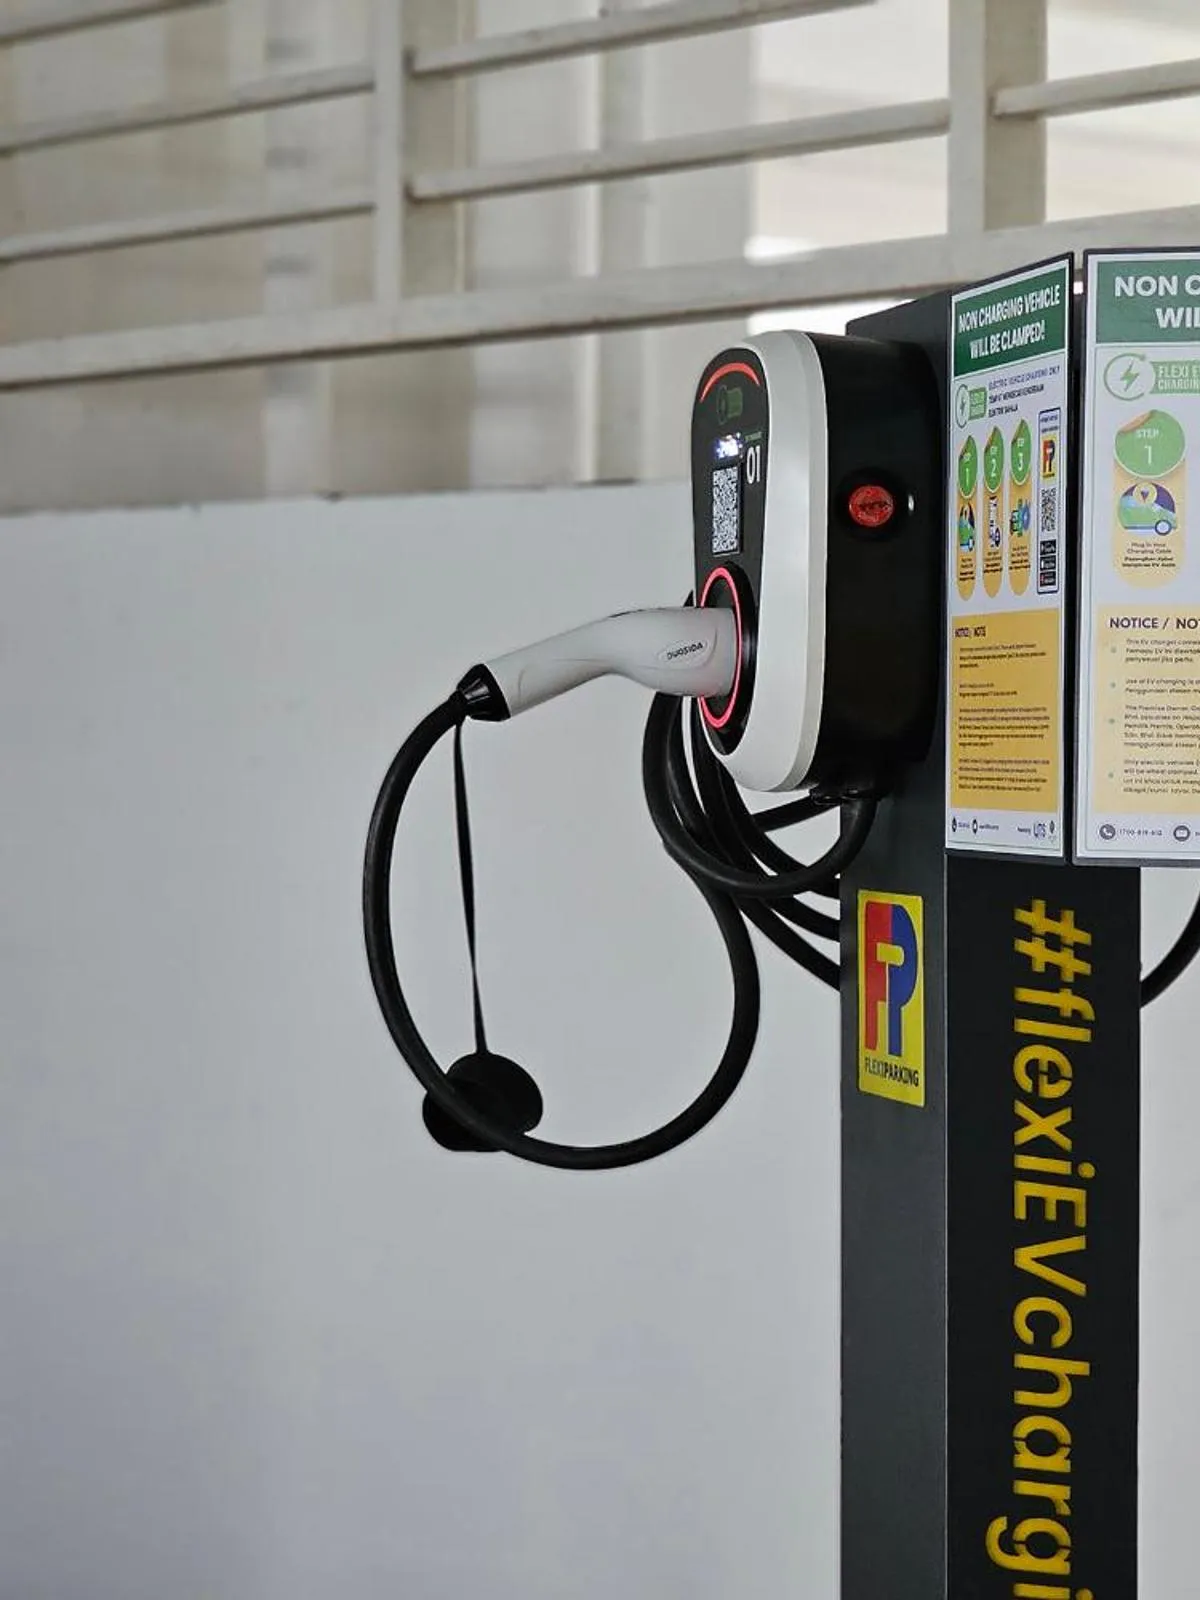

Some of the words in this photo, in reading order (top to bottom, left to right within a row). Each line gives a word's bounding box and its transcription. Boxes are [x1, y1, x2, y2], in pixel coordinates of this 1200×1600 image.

[1114, 275, 1178, 297] NON
[958, 311, 979, 334] NON
[979, 296, 1024, 327] CHARGING
[1024, 285, 1060, 314] VEHICLE
[969, 336, 989, 360] WILL
[989, 333, 1001, 354] BE
[1001, 319, 1046, 351] CLAMPED!
[1158, 365, 1190, 377] FLEXI
[1136, 428, 1159, 439] STEP
[746, 445, 761, 485] 01
[1144, 445, 1152, 465] 1
[990, 458, 997, 478] 2
[1109, 617, 1159, 629] NOTICE
[1162, 617, 1170, 630] /
[864, 1057, 919, 1088] FLEXIPARKING
